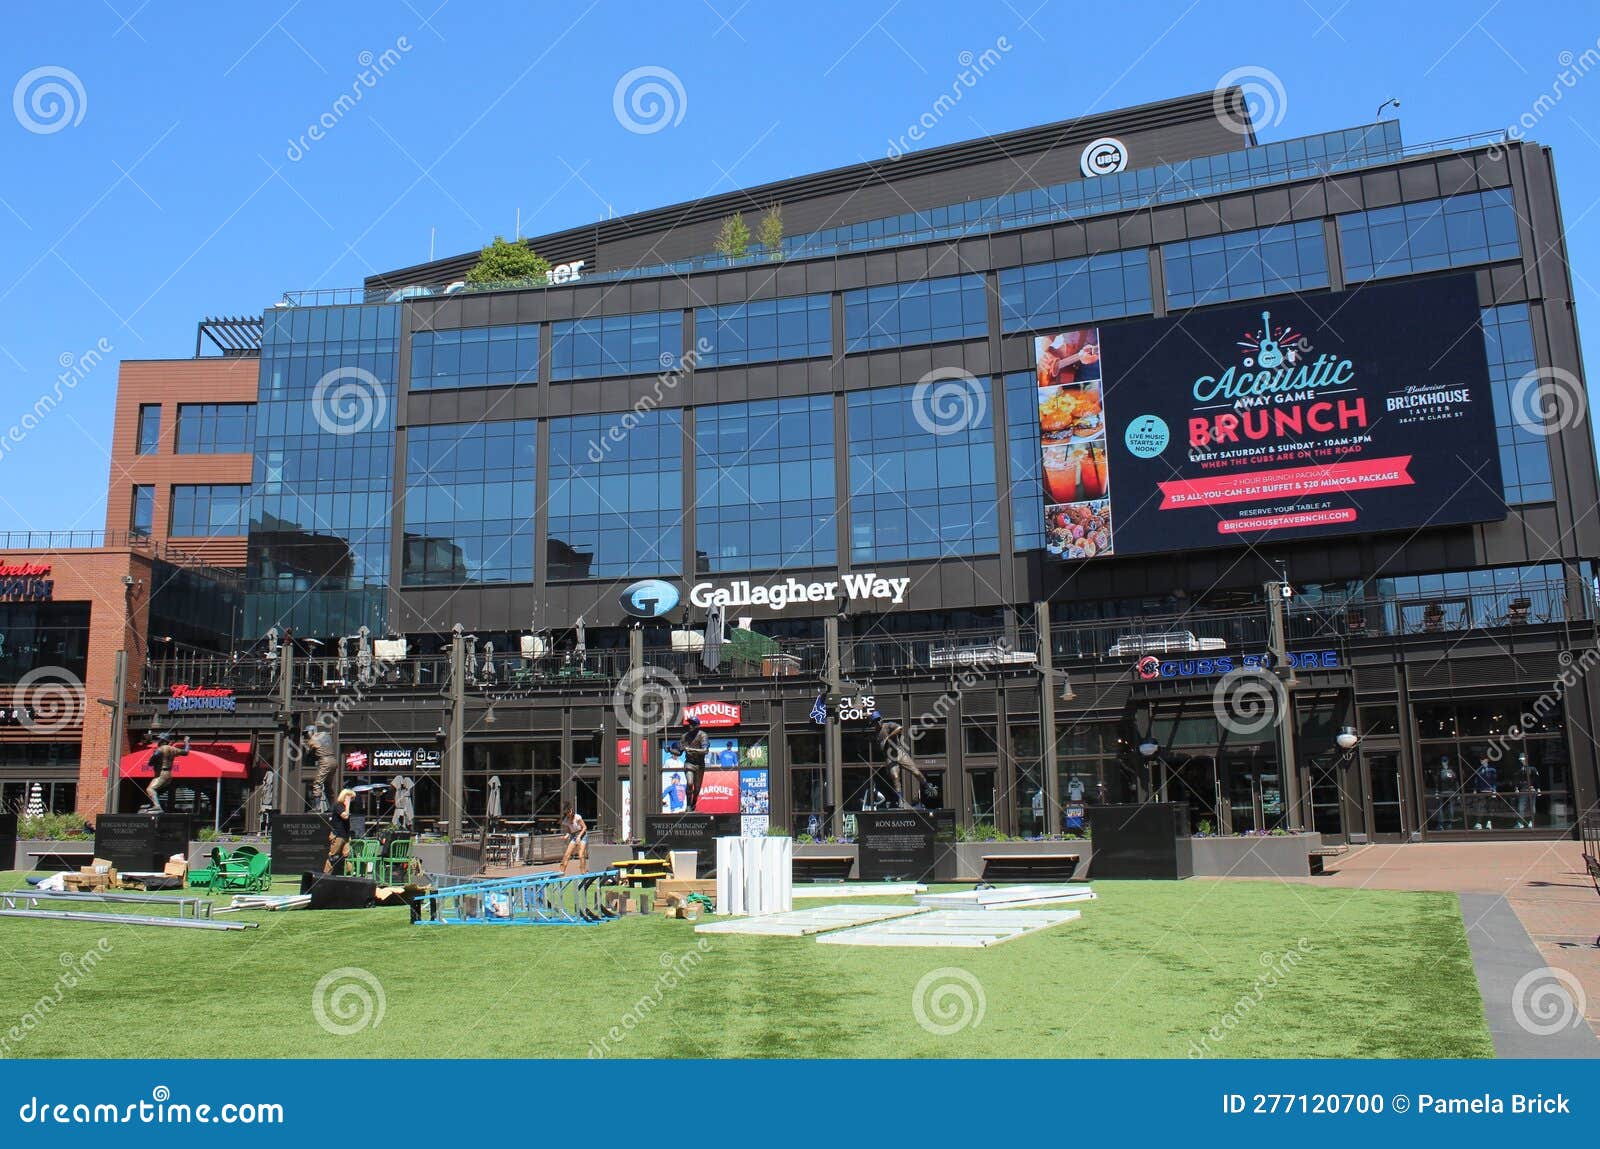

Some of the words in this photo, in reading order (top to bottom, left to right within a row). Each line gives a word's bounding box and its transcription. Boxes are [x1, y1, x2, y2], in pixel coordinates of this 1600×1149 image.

[1193, 354, 1355, 401] Acoustic
[1233, 395, 1273, 410] AWAY
[1275, 390, 1315, 404] GAME
[1386, 389, 1470, 411] BRICKHOUSE
[1188, 397, 1368, 448] BRUNCH
[1190, 453, 1218, 462] EVERY
[1220, 447, 1266, 459] SATURDAY
[1277, 441, 1315, 452] SUNDAY
[1324, 435, 1372, 447] 10AM-3PM
[1201, 460, 1228, 469] WHEN
[1231, 457, 1248, 466] THE
[1250, 454, 1274, 464] CUBS
[1276, 452, 1295, 461] ARE
[1314, 448, 1333, 457] THE
[1335, 445, 1362, 454] ROAD
[1187, 486, 1261, 500] ALL-YOU-CAN-EAT
[1262, 483, 1293, 493] BUFFET
[1303, 481, 1319, 489] $20
[1320, 476, 1357, 487] MIMOSA
[1358, 471, 1399, 483] PACKAGE
[1263, 473, 1294, 483] BRUNCH
[1295, 469, 1330, 479] PACKAGE
[1239, 507, 1273, 517] RESERVE
[1273, 505, 1295, 513] YOUR
[1295, 502, 1319, 511] TABLE
[1223, 512, 1350, 530] BRICKHOUSETAVERNCHI.COM
[690, 578, 837, 610] Gallagher
[841, 573, 910, 603] Way
[1160, 656, 1234, 678] CUBS
[171, 684, 235, 698] Budweiser
[168, 697, 237, 711] BRICKHOUSE
[684, 704, 738, 720] MARQUEE
[373, 758, 379, 766] &
[380, 758, 413, 766] DELIVERY
[374, 750, 412, 758] CARRYOUT
